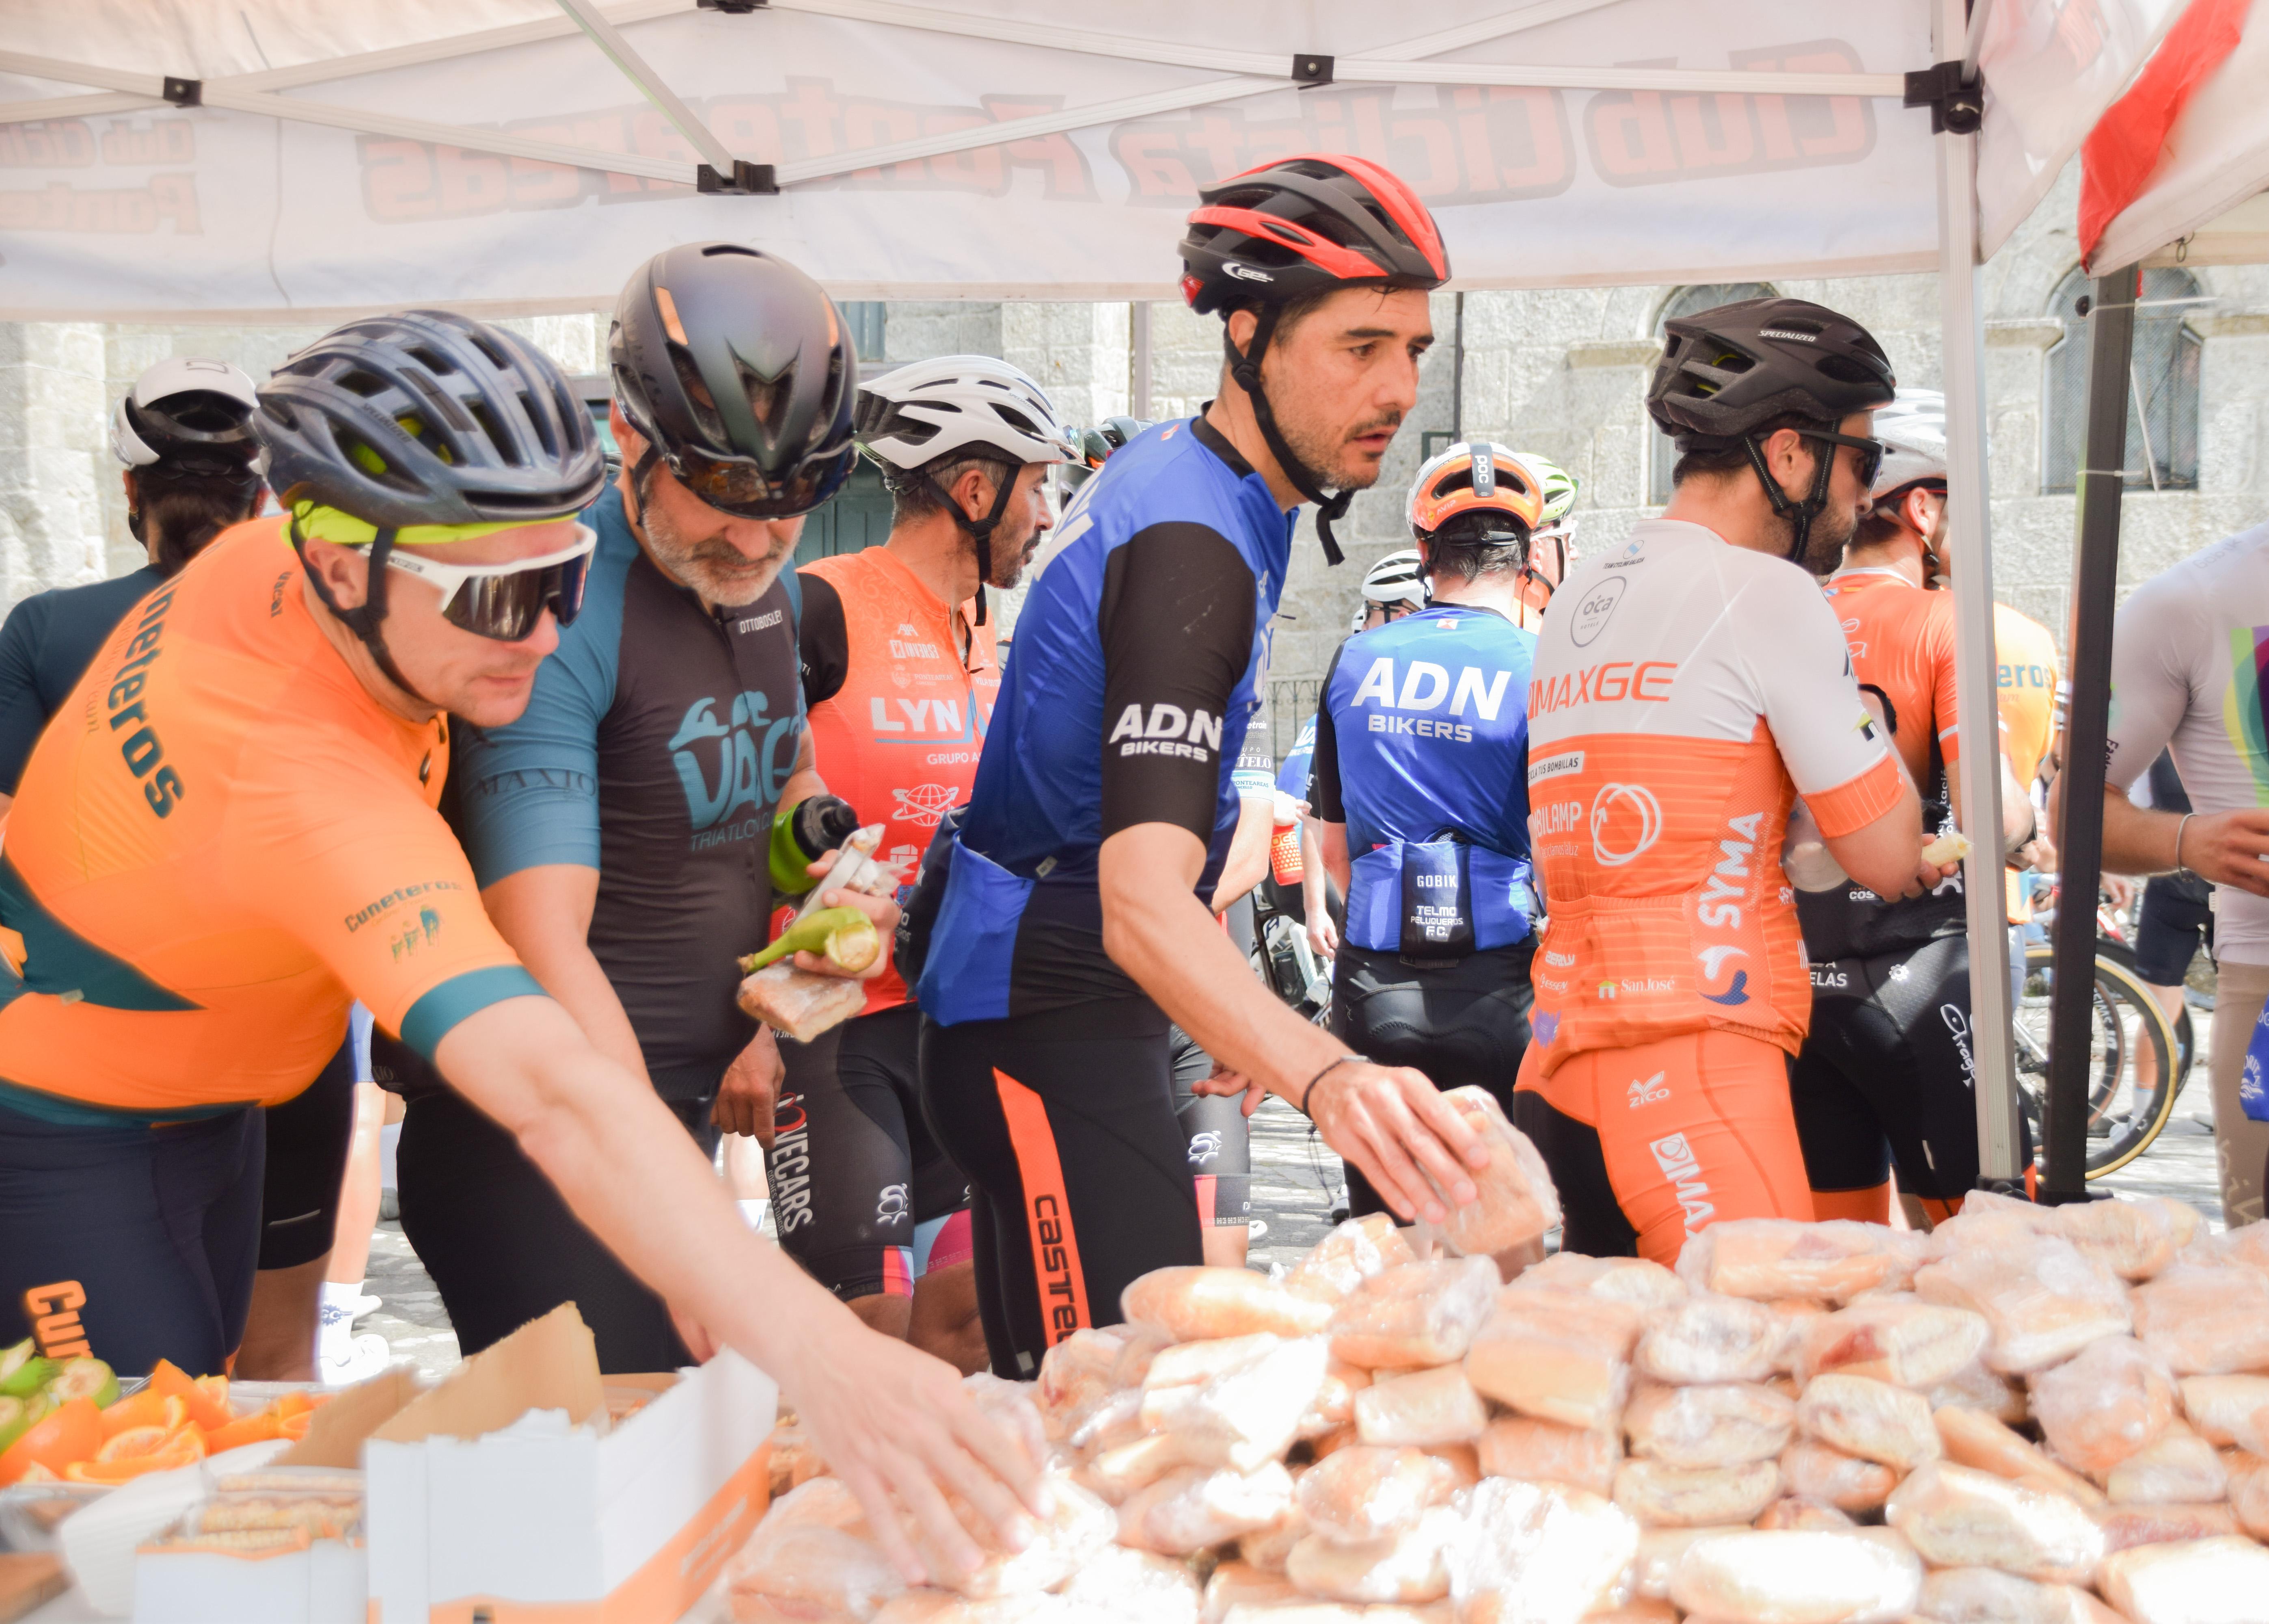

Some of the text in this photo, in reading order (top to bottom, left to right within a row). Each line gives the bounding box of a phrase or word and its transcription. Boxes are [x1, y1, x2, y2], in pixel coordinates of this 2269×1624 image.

[1758, 330, 1816, 342] SPECIALIZED
[740, 609, 783, 634] OTTOBOSLEY
[898, 624, 919, 637] AXA
[1580, 621, 1599, 629] HOTELS
[975, 677, 988, 685] VILA
[1350, 658, 1512, 721] ADN
[1109, 704, 1222, 751] ADN
[1368, 715, 1472, 743] BIKERS
[927, 752, 969, 764] GRUPO
[1121, 741, 1209, 763] BIKERS
[1538, 763, 1546, 775] TUS
[1547, 757, 1579, 772] BOMBILLAS
[691, 813, 761, 852] TRIATLON
[1698, 812, 1764, 929] SYMA
[1417, 875, 1457, 887] GOBIK
[345, 880, 464, 933] Cuneteros
[1417, 906, 1457, 916] TELMO
[1410, 916, 1464, 925] PELUQUEROS
[1426, 926, 1448, 936] F.C.
[1621, 975, 1675, 992] San José
[1629, 1088, 1669, 1108] ZICO
[767, 1169, 777, 1199] COCHES
[774, 1206, 786, 1237] FURGOS
